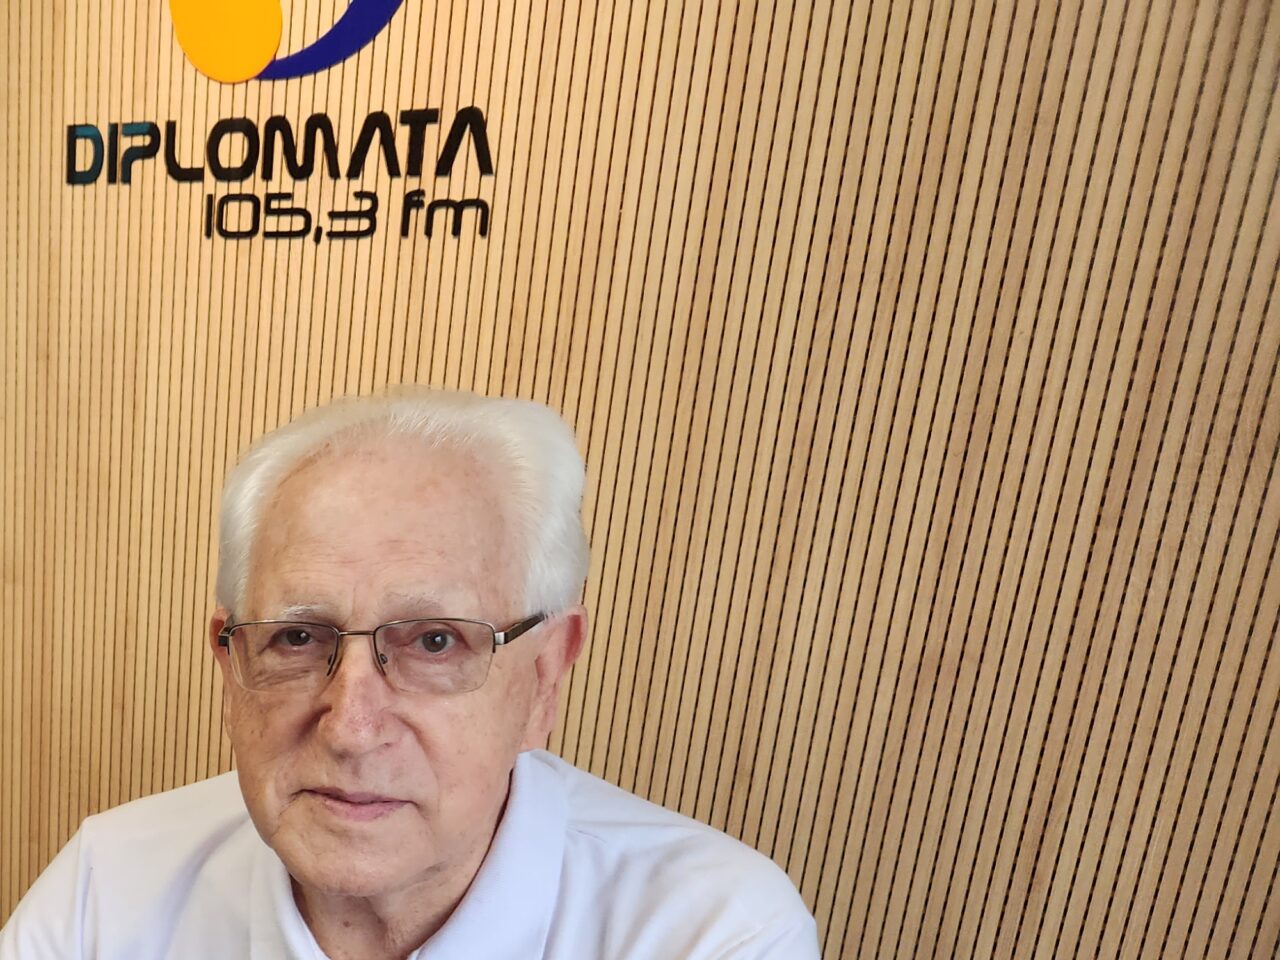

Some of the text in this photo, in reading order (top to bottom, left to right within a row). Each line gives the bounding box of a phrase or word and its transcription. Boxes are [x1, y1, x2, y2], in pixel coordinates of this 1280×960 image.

[66, 106, 493, 185] DIPLOMATA
[205, 189, 489, 244] 105,3 fm
